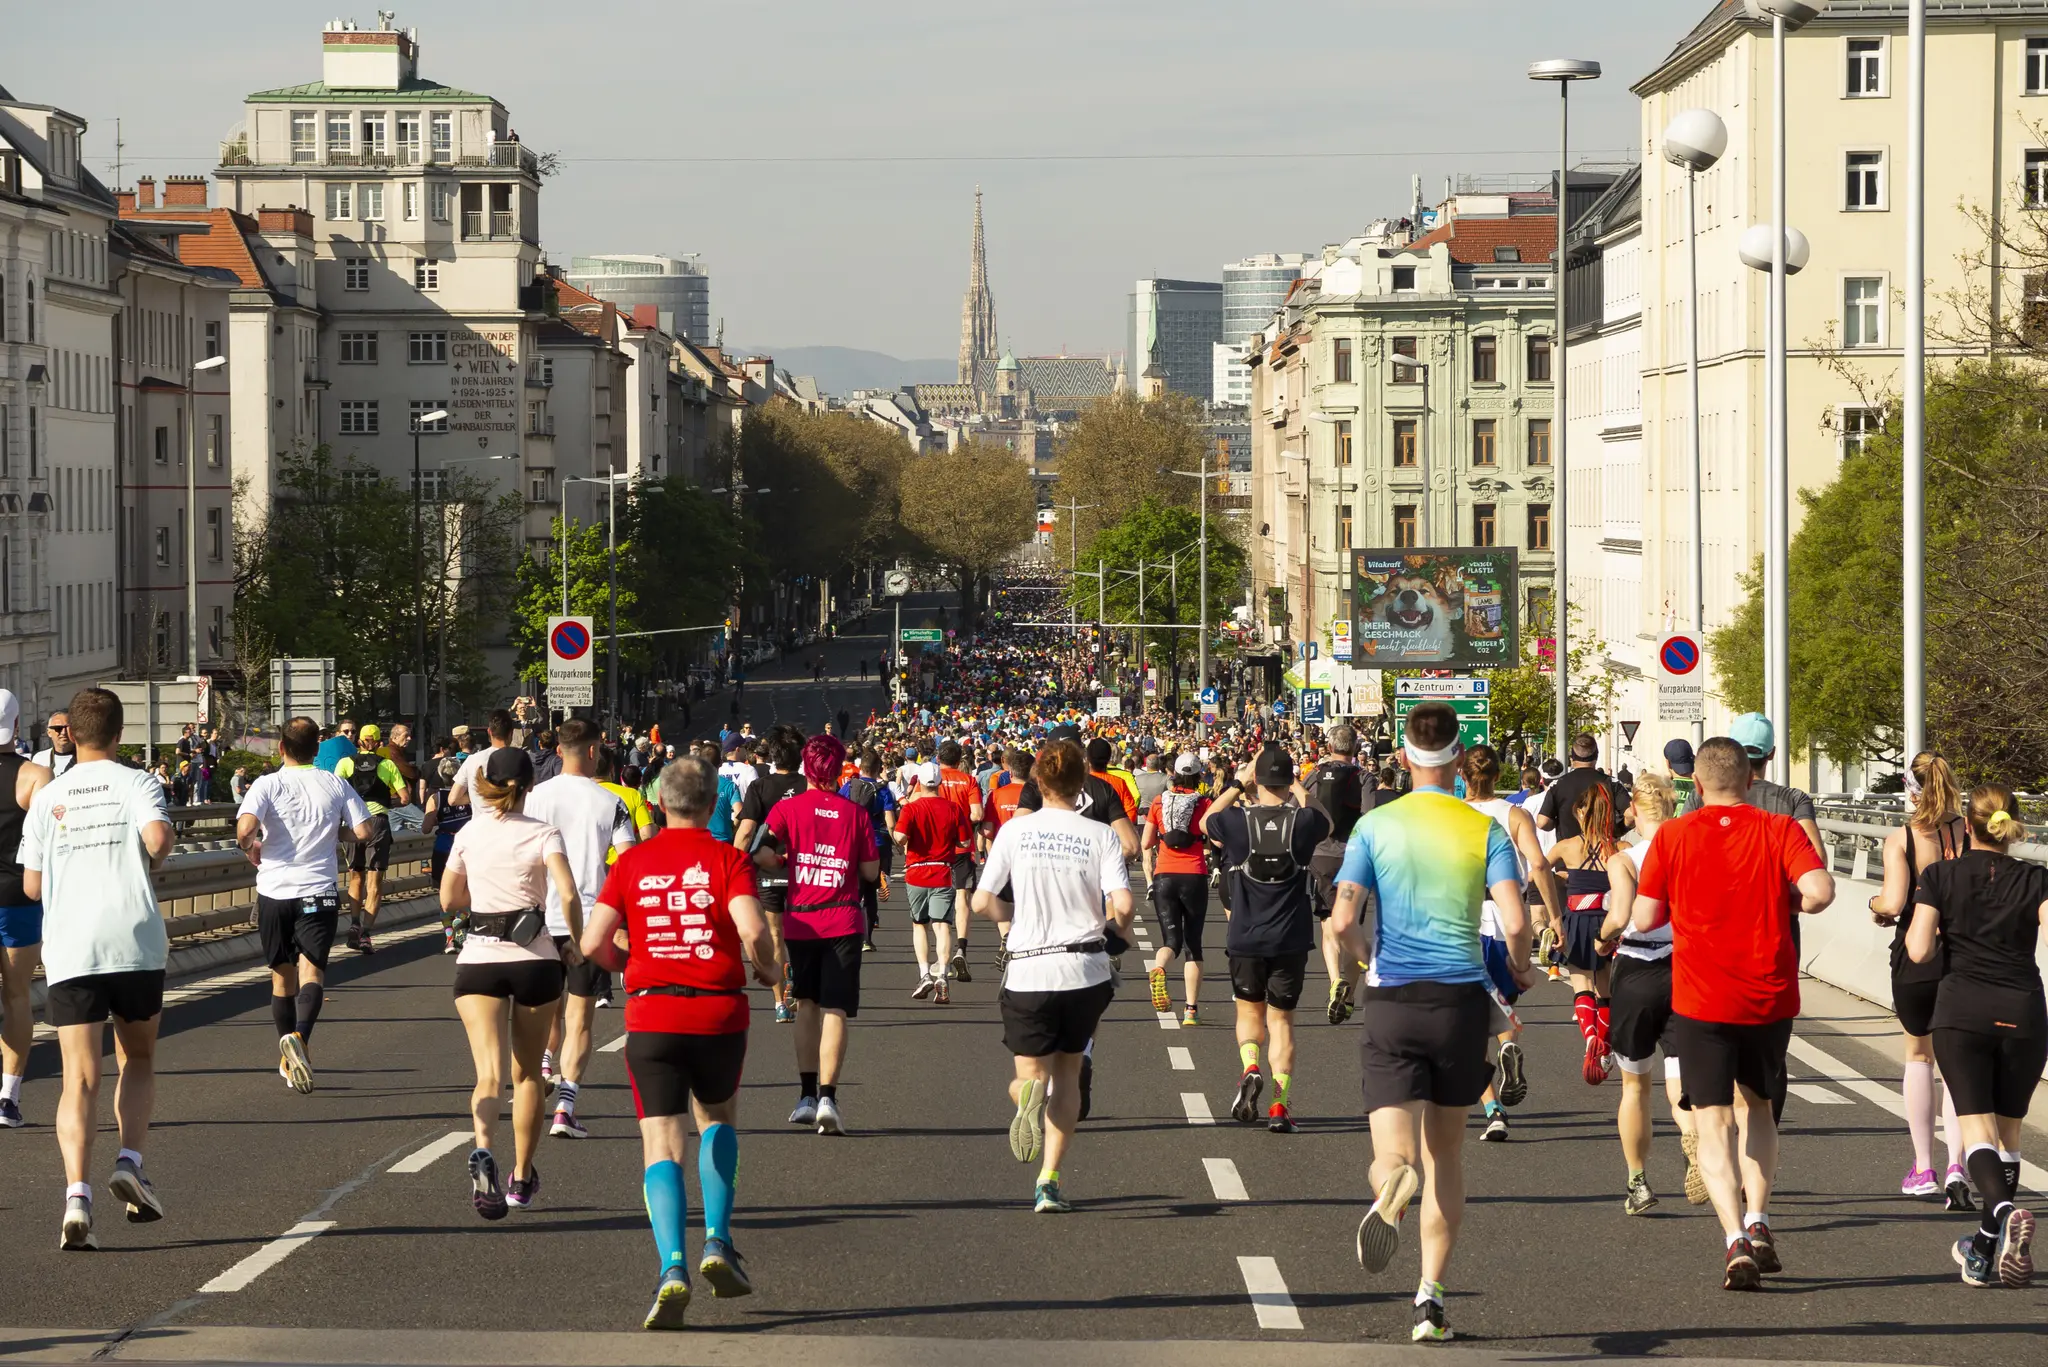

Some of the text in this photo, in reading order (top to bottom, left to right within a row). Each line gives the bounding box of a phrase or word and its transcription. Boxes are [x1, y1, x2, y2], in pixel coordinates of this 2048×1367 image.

[450, 332, 515, 341] ERBAUT VON DER
[451, 343, 515, 358] GEMEINDE
[468, 360, 500, 374] WIEN
[451, 376, 515, 386] IN DEN JAHREN
[460, 387, 507, 397] 1924-1925
[452, 399, 515, 409] AUS DEN MITTELN
[474, 411, 492, 420] DER
[449, 422, 516, 432] WOHNBAUSTEUER
[1367, 561, 1401, 569] Vitakraft
[1364, 622, 1391, 630] MEHR
[1364, 631, 1421, 639] GESCHMACK
[549, 669, 592, 680] Kurzparkzone
[1414, 682, 1482, 692] Zentrum 8
[1659, 684, 1701, 695] Kurzparkzone
[1304, 693, 1322, 708] FH
[68, 784, 110, 796] FINISHER
[815, 807, 839, 819] NEOS
[1021, 831, 1091, 846] 22 WACHAU
[815, 843, 836, 856] WIR
[1020, 842, 1090, 857] MARATHON
[797, 853, 849, 869] BEWEGEN
[795, 865, 845, 888] WIEN
